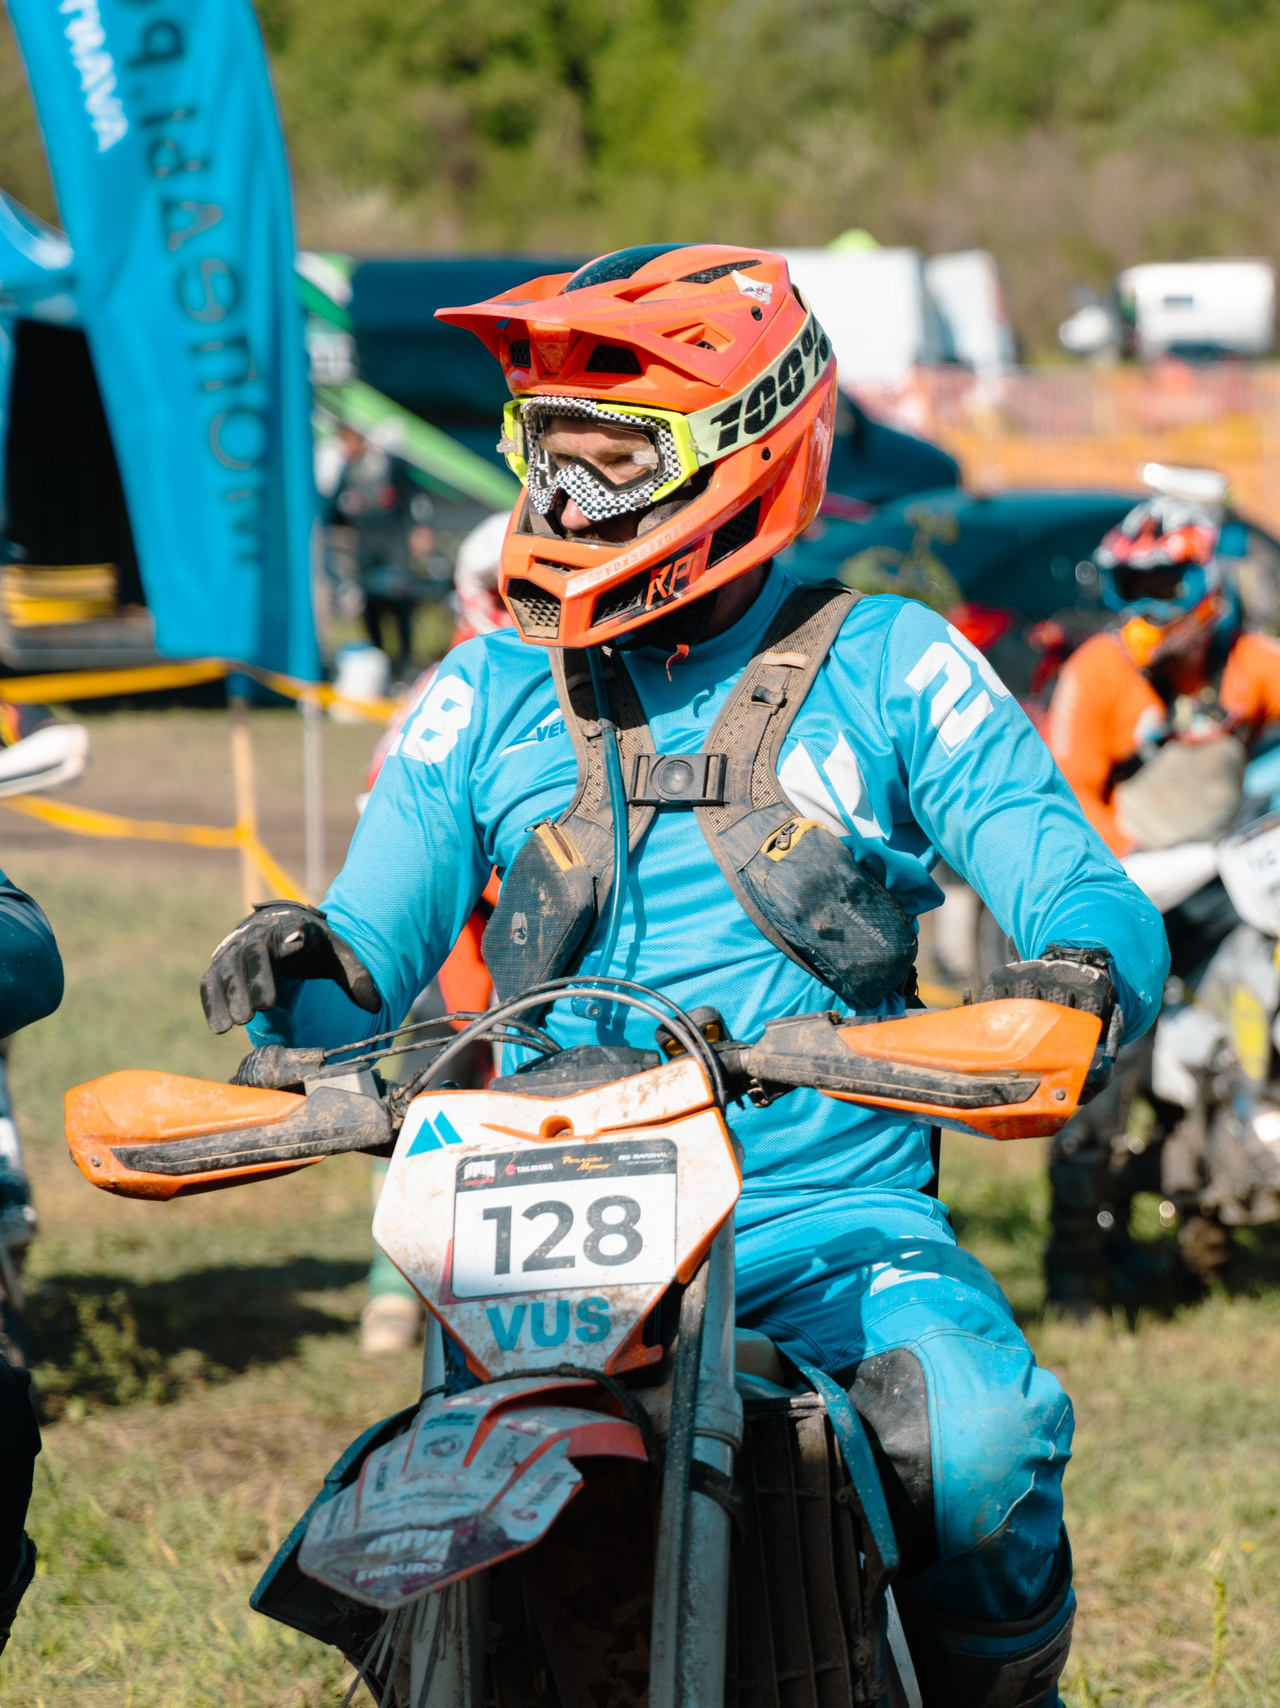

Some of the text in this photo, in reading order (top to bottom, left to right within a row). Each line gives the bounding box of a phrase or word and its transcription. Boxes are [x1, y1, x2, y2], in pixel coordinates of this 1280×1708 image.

[710, 313, 829, 451] 100%
[388, 669, 474, 766] 8
[482, 1195, 643, 1276] 128
[486, 1297, 613, 1352] VUS
[356, 1561, 444, 1582] ENDURO
